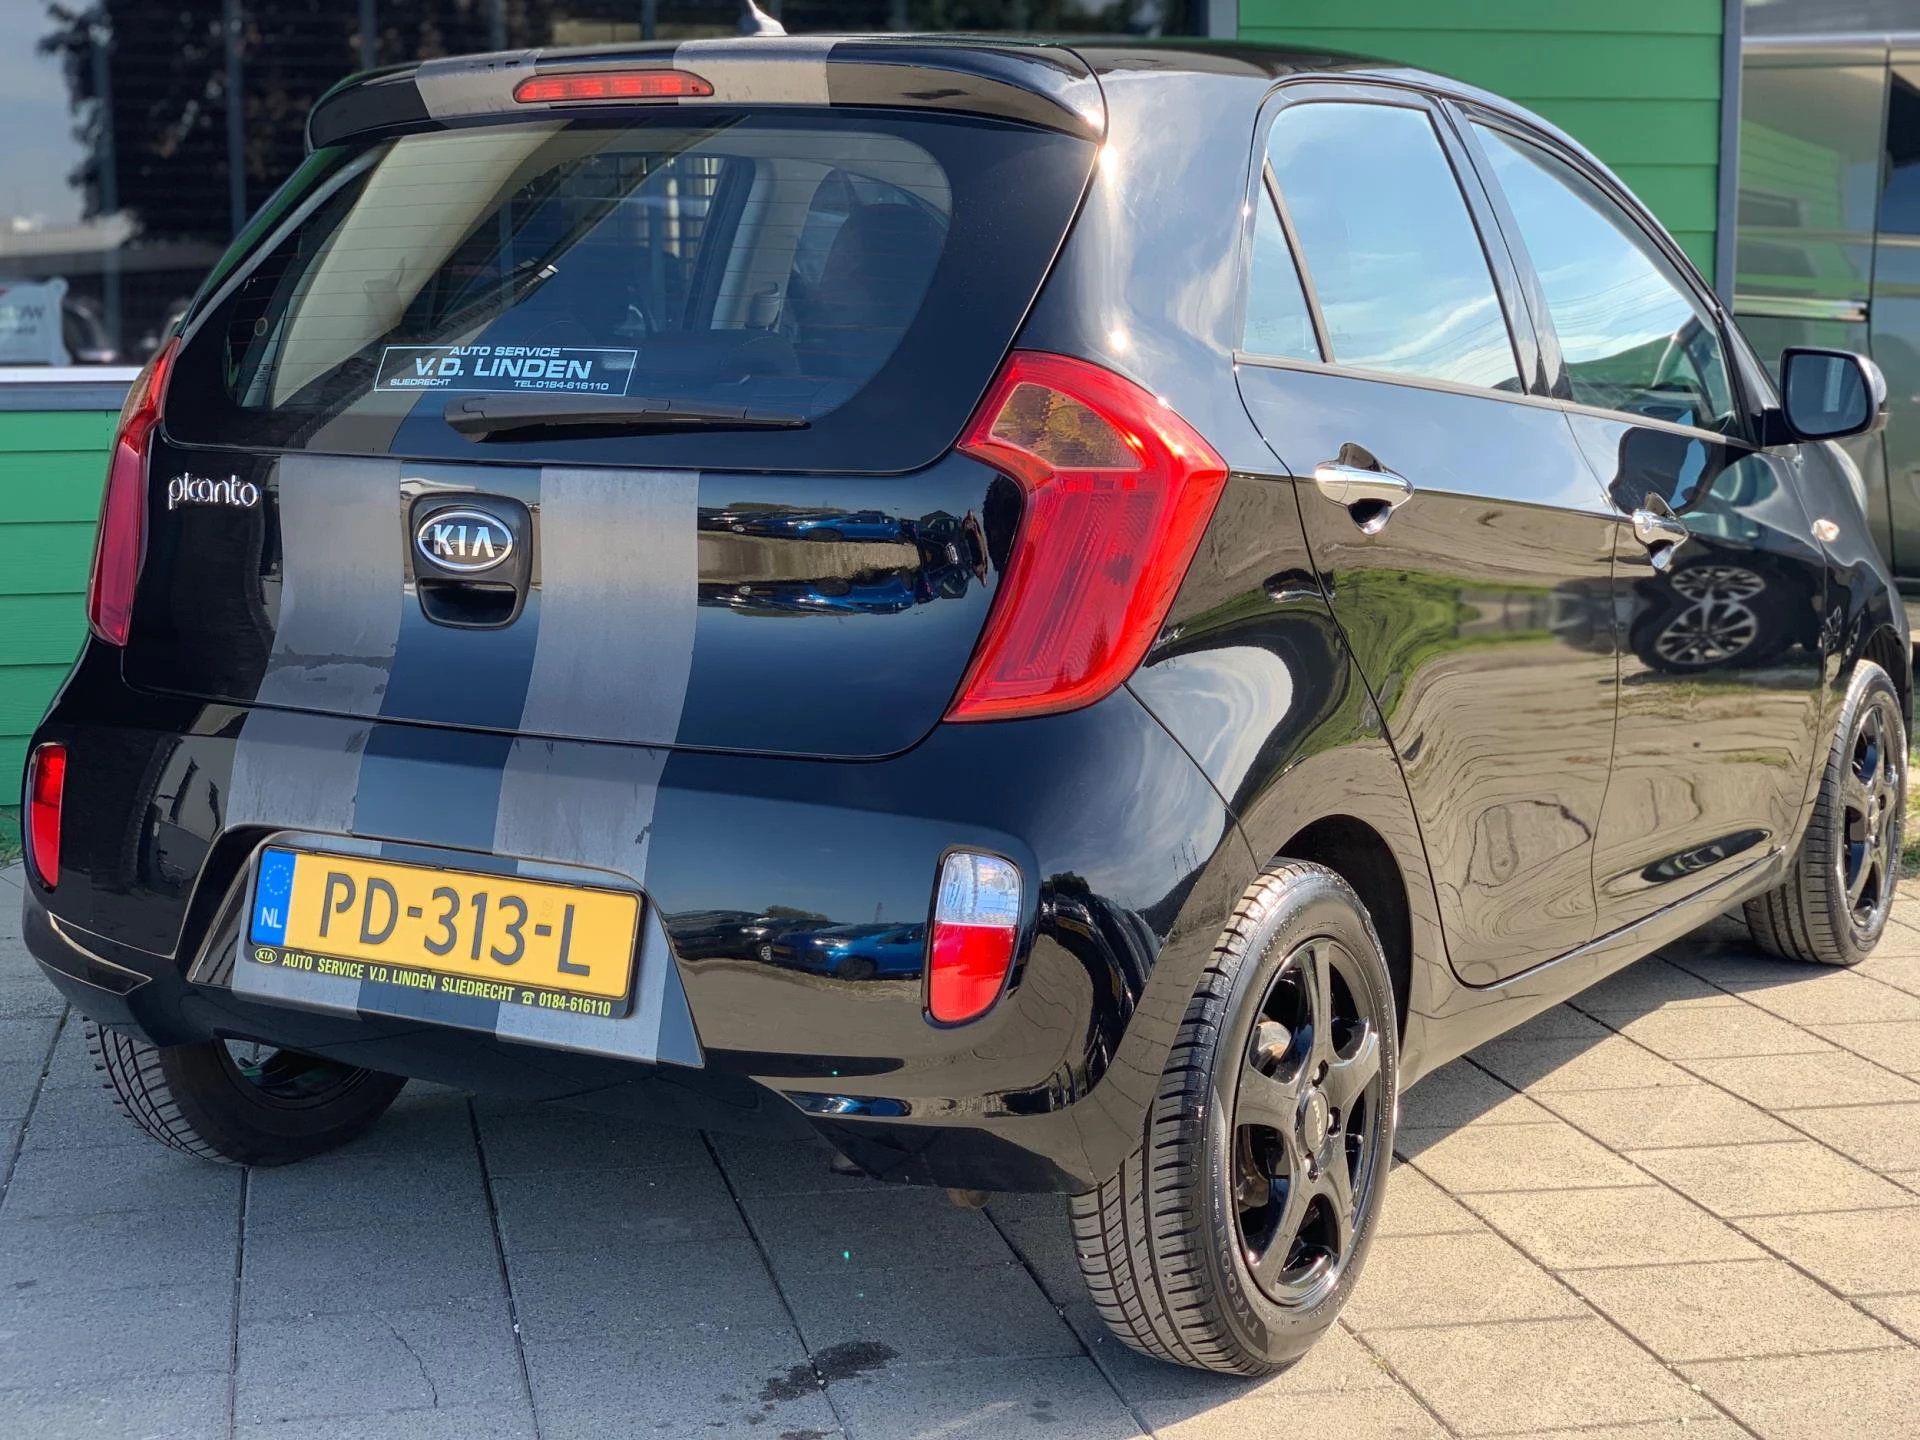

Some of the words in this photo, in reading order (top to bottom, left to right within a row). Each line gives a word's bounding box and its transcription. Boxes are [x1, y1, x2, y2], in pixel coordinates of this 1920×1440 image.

[449, 346, 491, 356] AUTO
[494, 346, 562, 357] SERVICE
[390, 378, 452, 386] SLIEDRECHT
[415, 357, 465, 376] V.D.
[473, 358, 593, 379] LINDEN
[432, 523, 496, 559] KIA
[261, 906, 282, 929] NL
[319, 871, 591, 977] PD-313-L
[282, 953, 313, 971] AUTO
[317, 958, 364, 979] SERVICE
[368, 966, 389, 983] V.D.
[392, 969, 436, 990] LINDEN
[441, 977, 515, 1002] SLIEDRECHT
[538, 993, 612, 1017] 0184-616110
[1211, 1225, 1259, 1340] TYFOON
